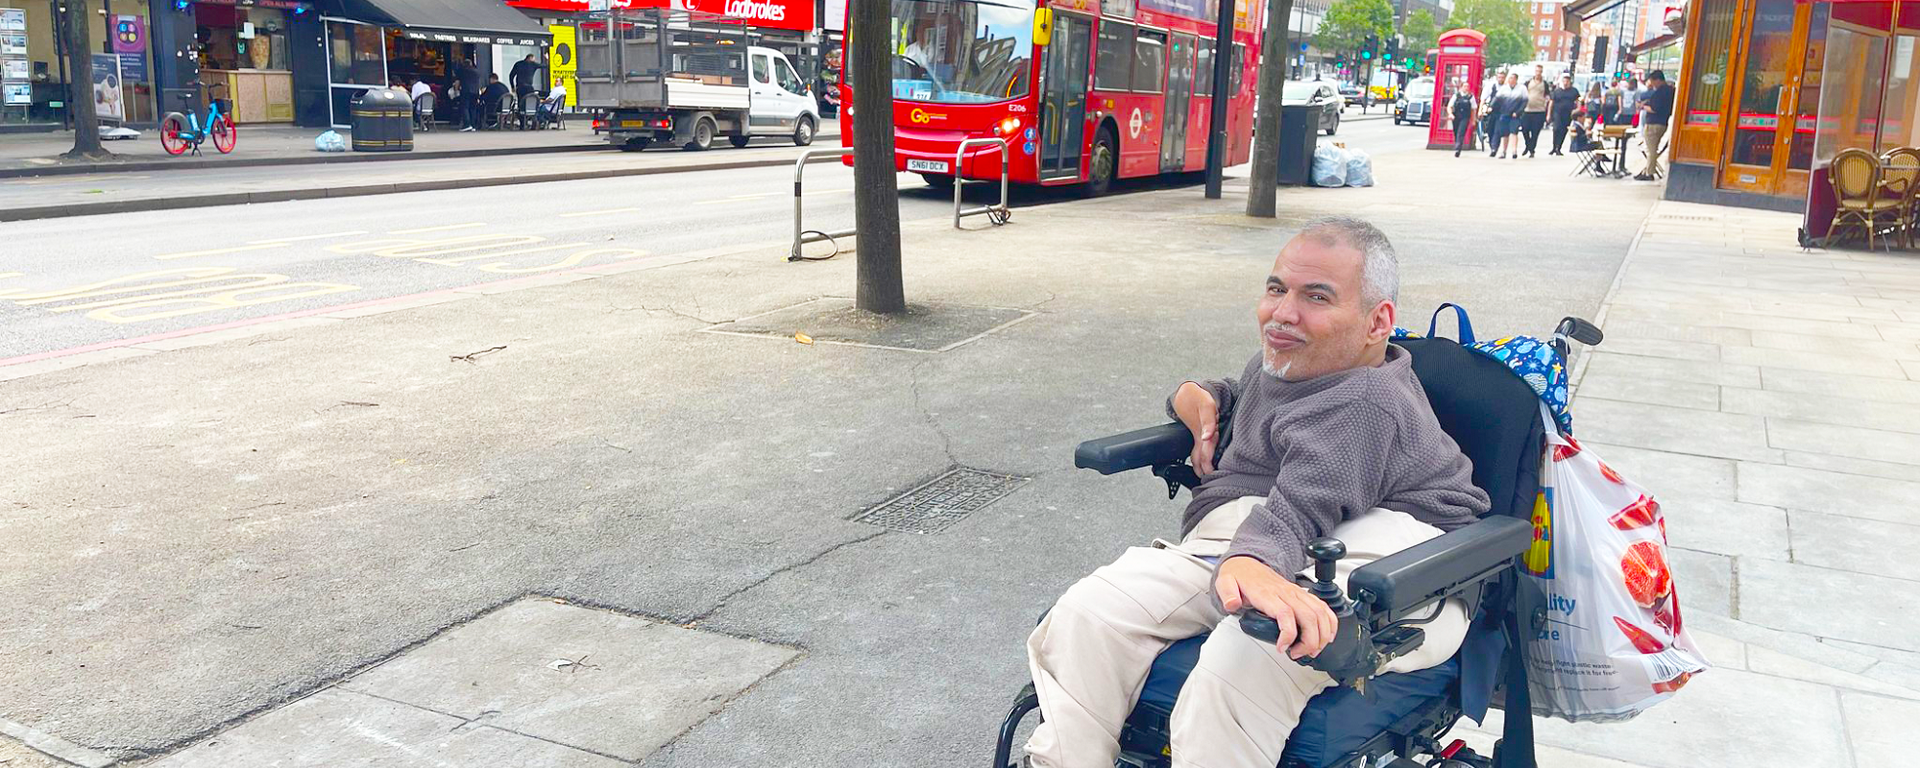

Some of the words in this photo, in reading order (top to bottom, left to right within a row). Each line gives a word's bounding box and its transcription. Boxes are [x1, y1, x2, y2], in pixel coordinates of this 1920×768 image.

[725, 0, 786, 21] Ladbrokes
[496, 37, 514, 45] COFFEE
[1008, 104, 1027, 112] E206
[910, 108, 930, 123] Go
[911, 160, 928, 169] SN61
[929, 162, 945, 170] DCX
